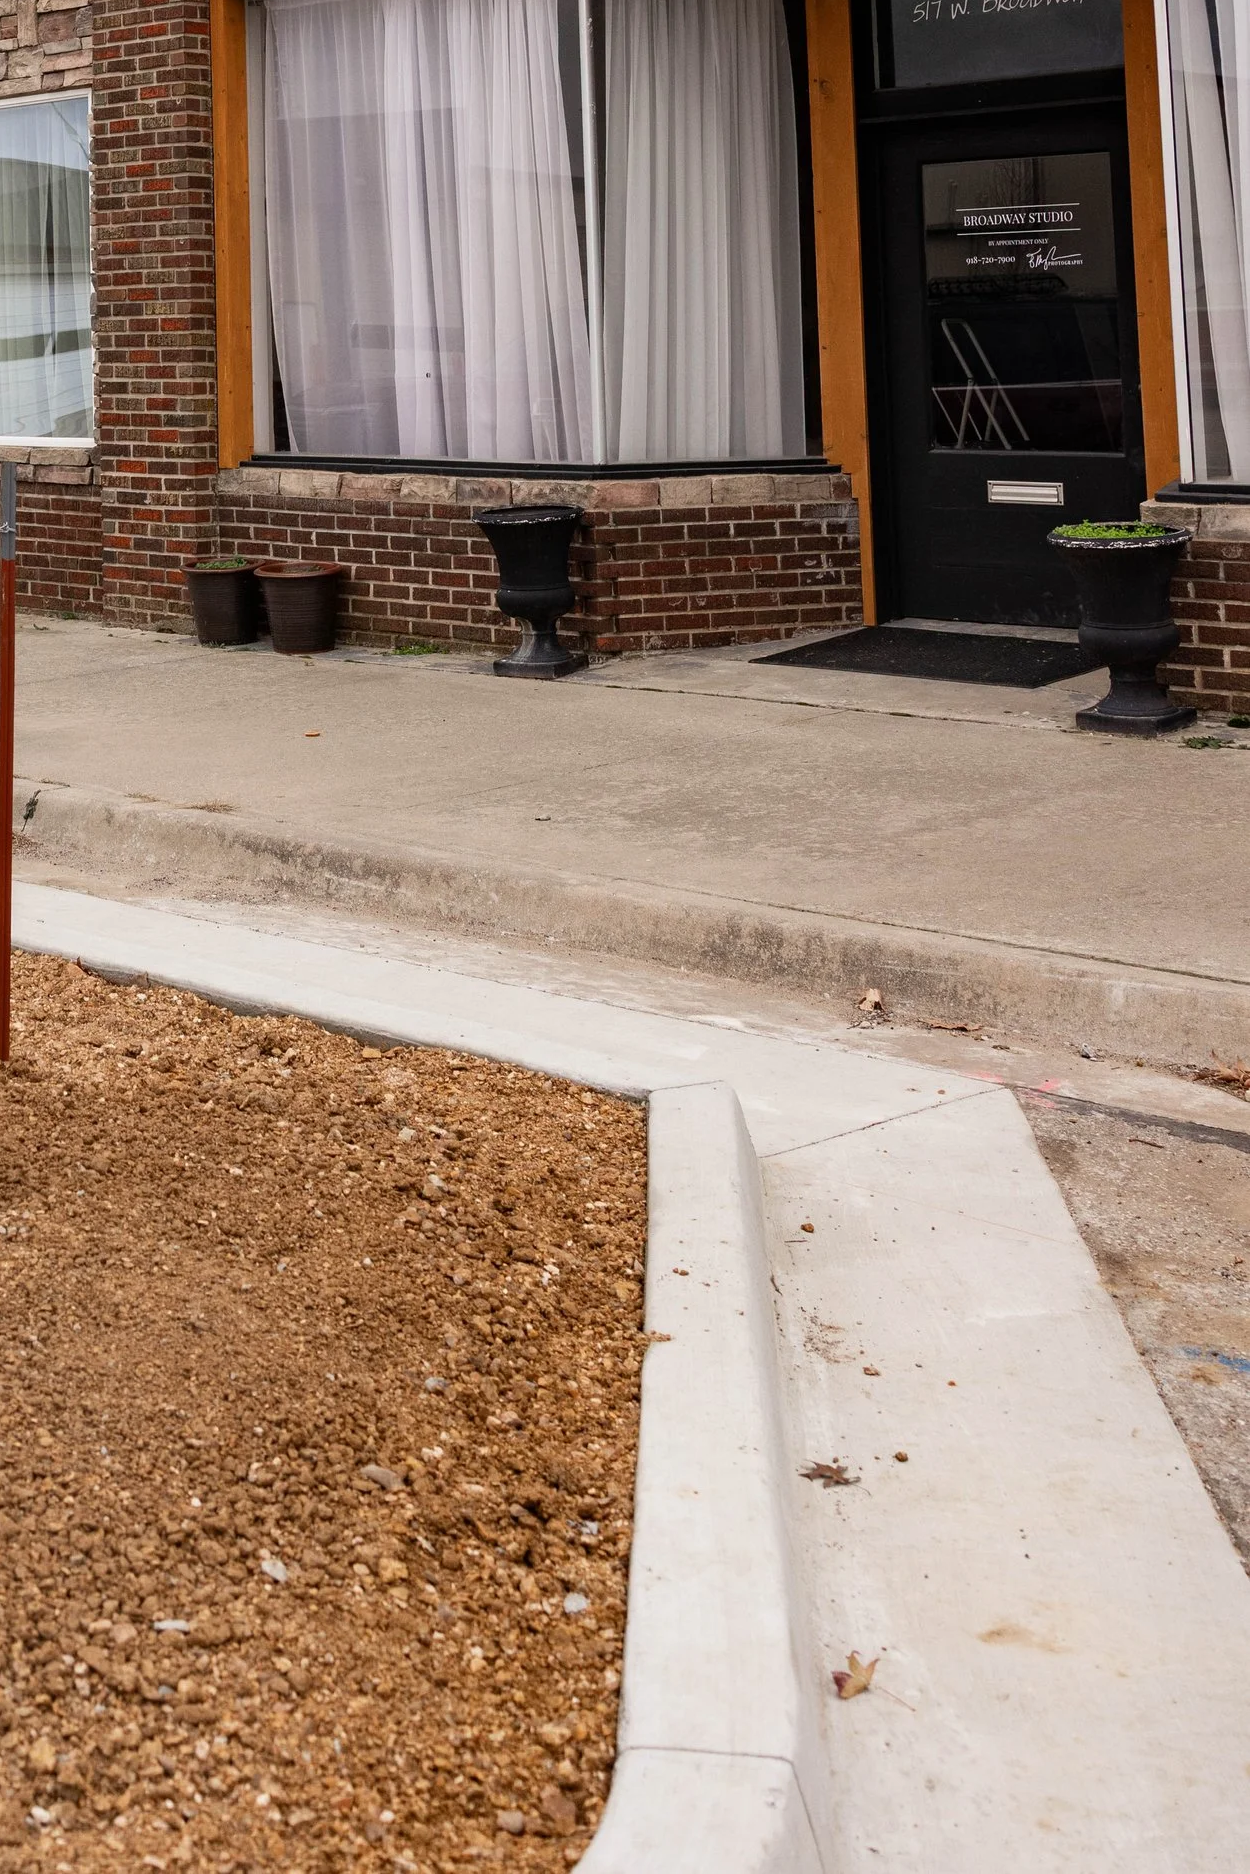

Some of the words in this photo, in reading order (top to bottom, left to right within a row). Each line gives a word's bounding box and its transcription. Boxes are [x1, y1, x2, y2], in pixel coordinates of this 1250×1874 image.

[912, 0, 942, 23] 517
[951, 0, 970, 20] W.
[963, 213, 1026, 227] BROADWAY
[1028, 210, 1073, 224] STUDIO
[965, 255, 1016, 265] 918-720-7900
